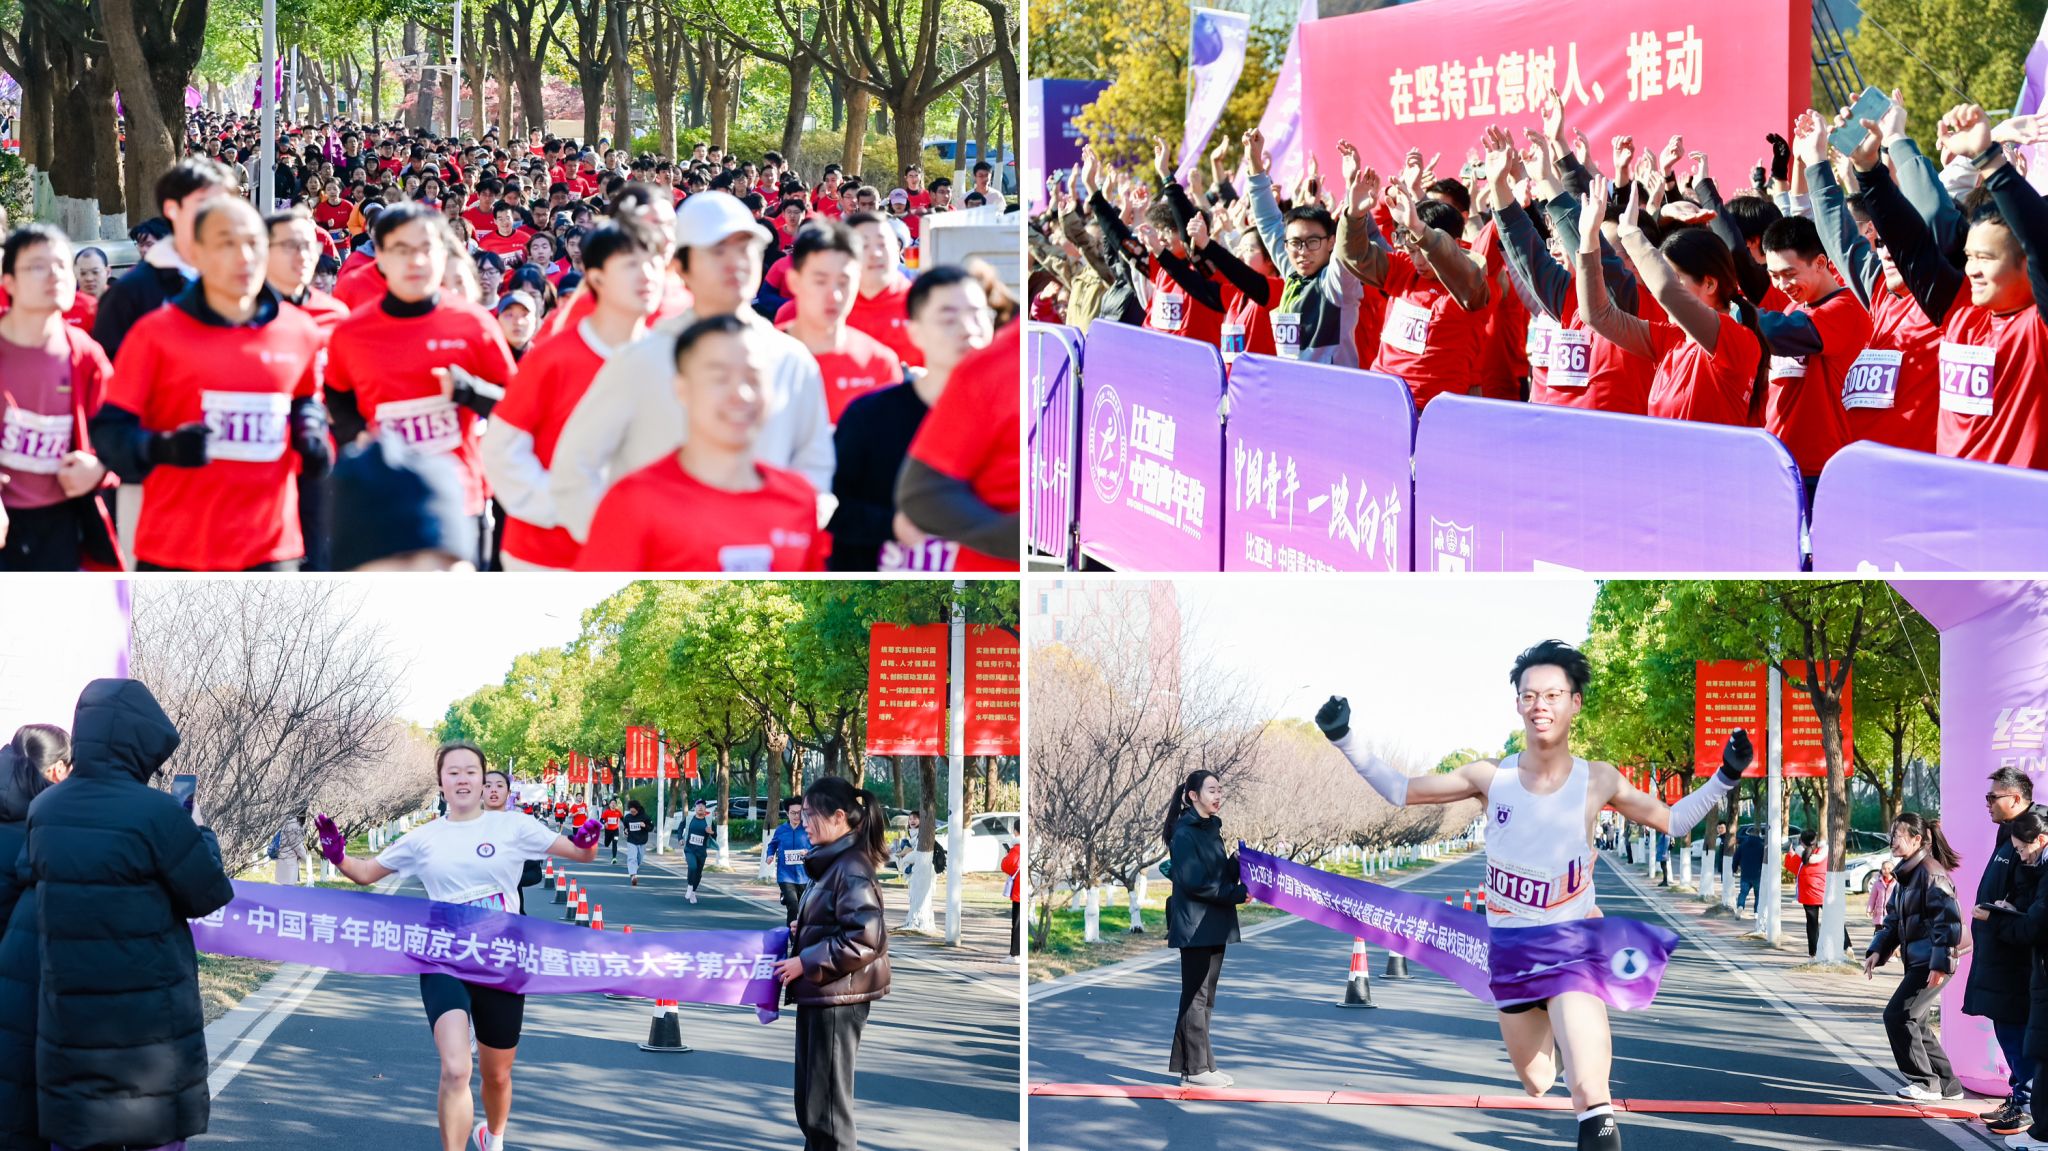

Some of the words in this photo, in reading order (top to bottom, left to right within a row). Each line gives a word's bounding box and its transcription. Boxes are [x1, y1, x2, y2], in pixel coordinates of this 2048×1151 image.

[1129, 403, 1176, 461] 比亚迪
[1128, 454, 1206, 529] 中国青年跑
